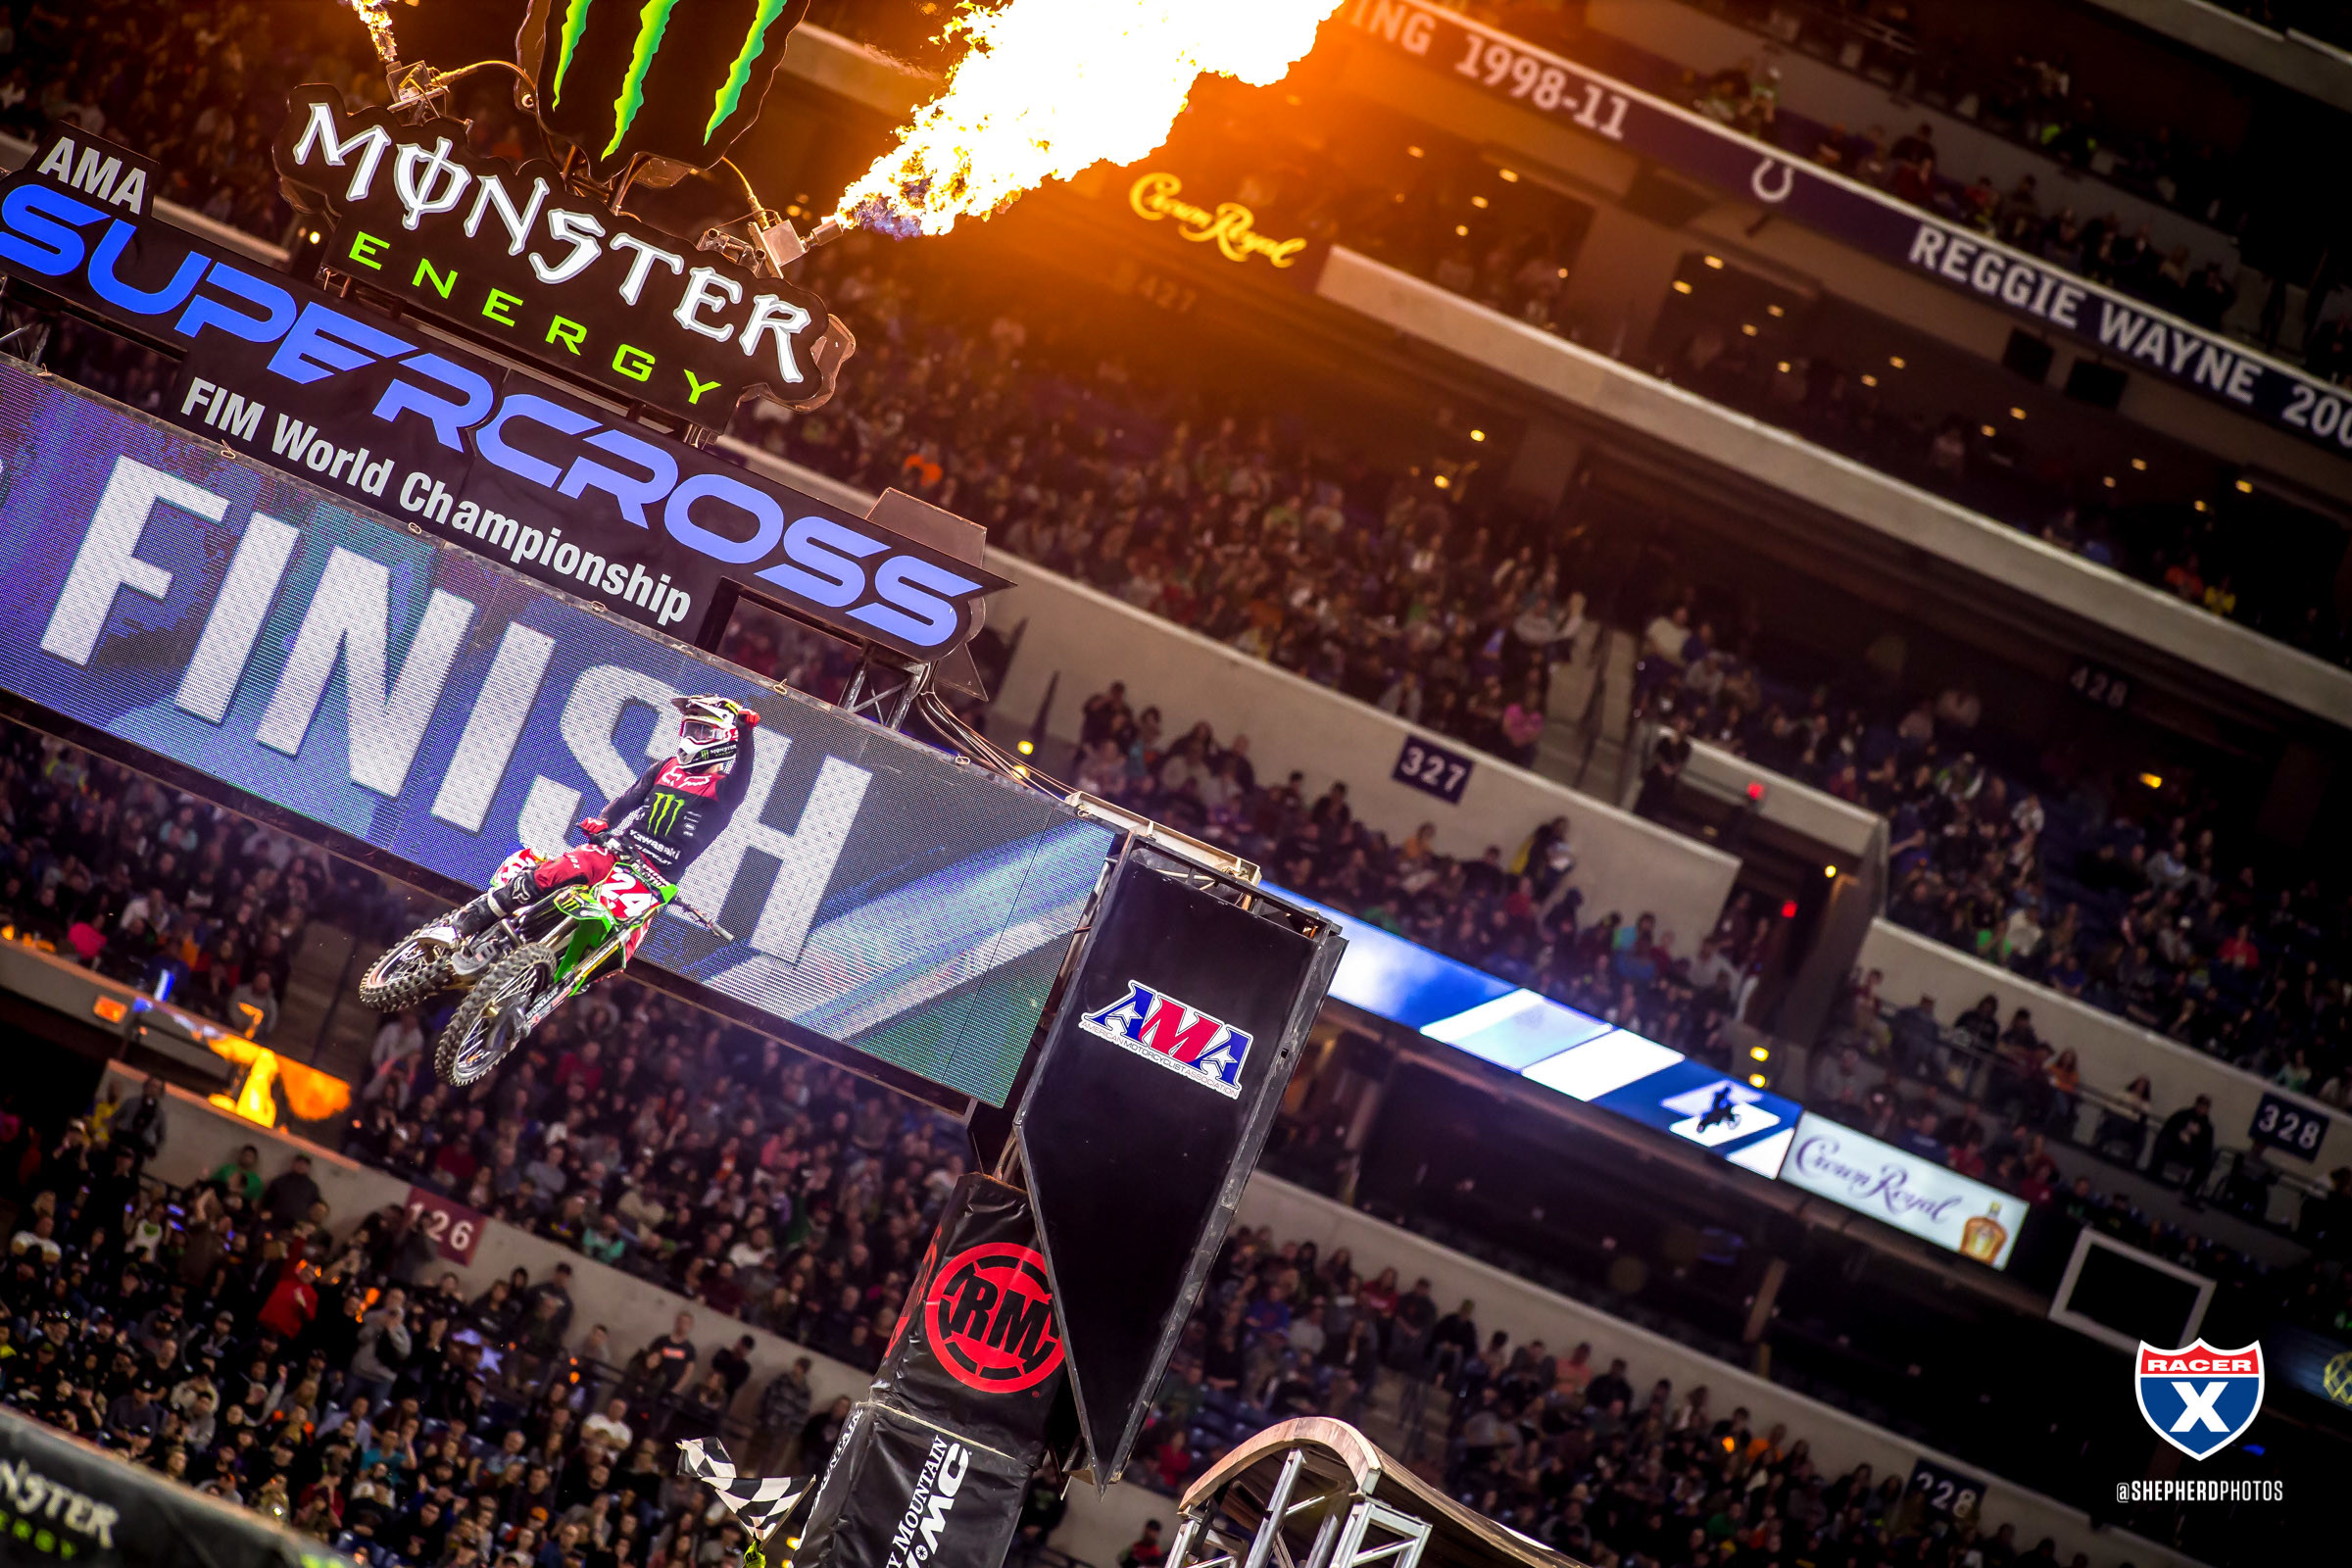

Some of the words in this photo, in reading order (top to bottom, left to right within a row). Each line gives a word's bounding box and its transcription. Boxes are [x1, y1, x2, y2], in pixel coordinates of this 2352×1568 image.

[1454, 33, 1629, 140] 1998-11
[37, 135, 149, 215] AMA
[294, 102, 811, 383] MONSTER
[348, 230, 721, 405] ENERGY
[1909, 223, 2086, 330] REGGIE
[2098, 299, 2263, 405] WAYNE
[0, 183, 984, 647] SUPERCROSS
[180, 376, 266, 443] FIM
[271, 414, 395, 498] World
[399, 470, 692, 625] Championship
[39, 454, 875, 966] FINISH
[1400, 746, 1466, 793] 327
[600, 869, 657, 919] 24
[1080, 1020, 1124, 1046] AMERICAN
[1123, 1040, 1186, 1073] MOTORCYCLIST
[1185, 1068, 1239, 1099] ASSOCIATION
[1083, 981, 1252, 1090] AMA
[1795, 1135, 1871, 1188] Crown
[1847, 1164, 1964, 1224] Royal
[2258, 1103, 2321, 1151] 328
[411, 1201, 474, 1251] 126
[949, 1275, 1052, 1358] RM
[892, 1434, 949, 1555] MOUNTAIN
